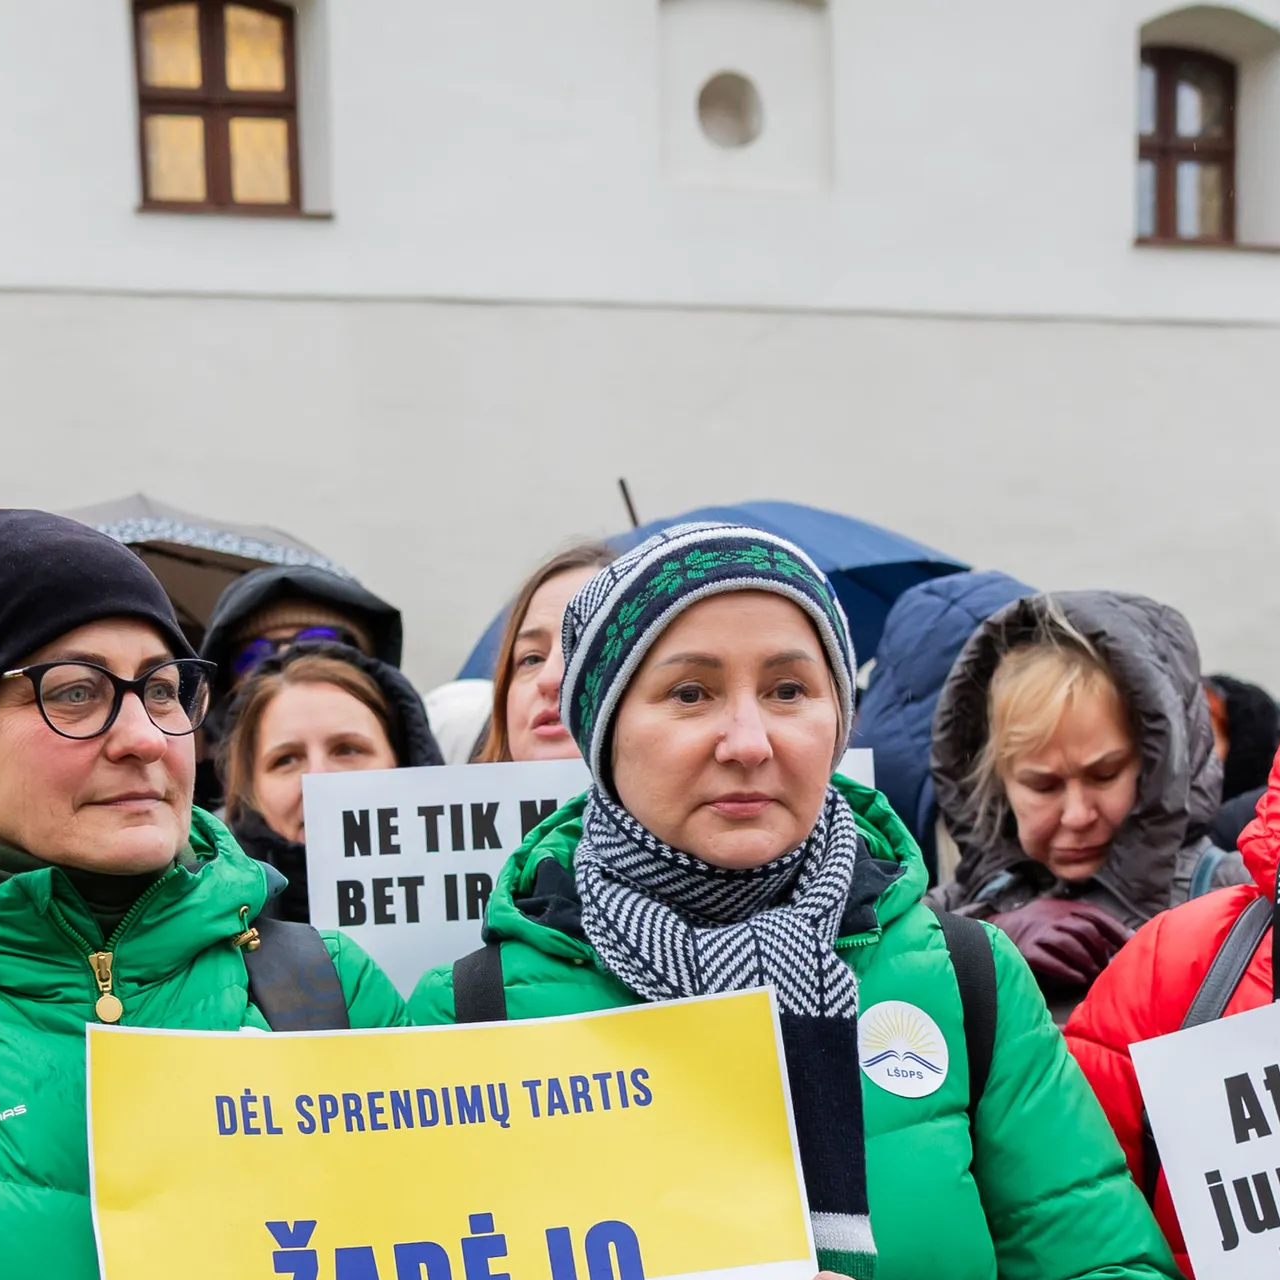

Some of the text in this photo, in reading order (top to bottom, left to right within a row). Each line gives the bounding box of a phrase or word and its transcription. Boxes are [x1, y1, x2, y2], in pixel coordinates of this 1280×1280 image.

[342, 807, 401, 858] NE
[417, 802, 503, 853] TIK
[336, 872, 493, 927] BET IR
[886, 1067, 924, 1080] LŠDPS
[215, 1068, 652, 1135] DĖL SPRENDIMŲ TARTIS
